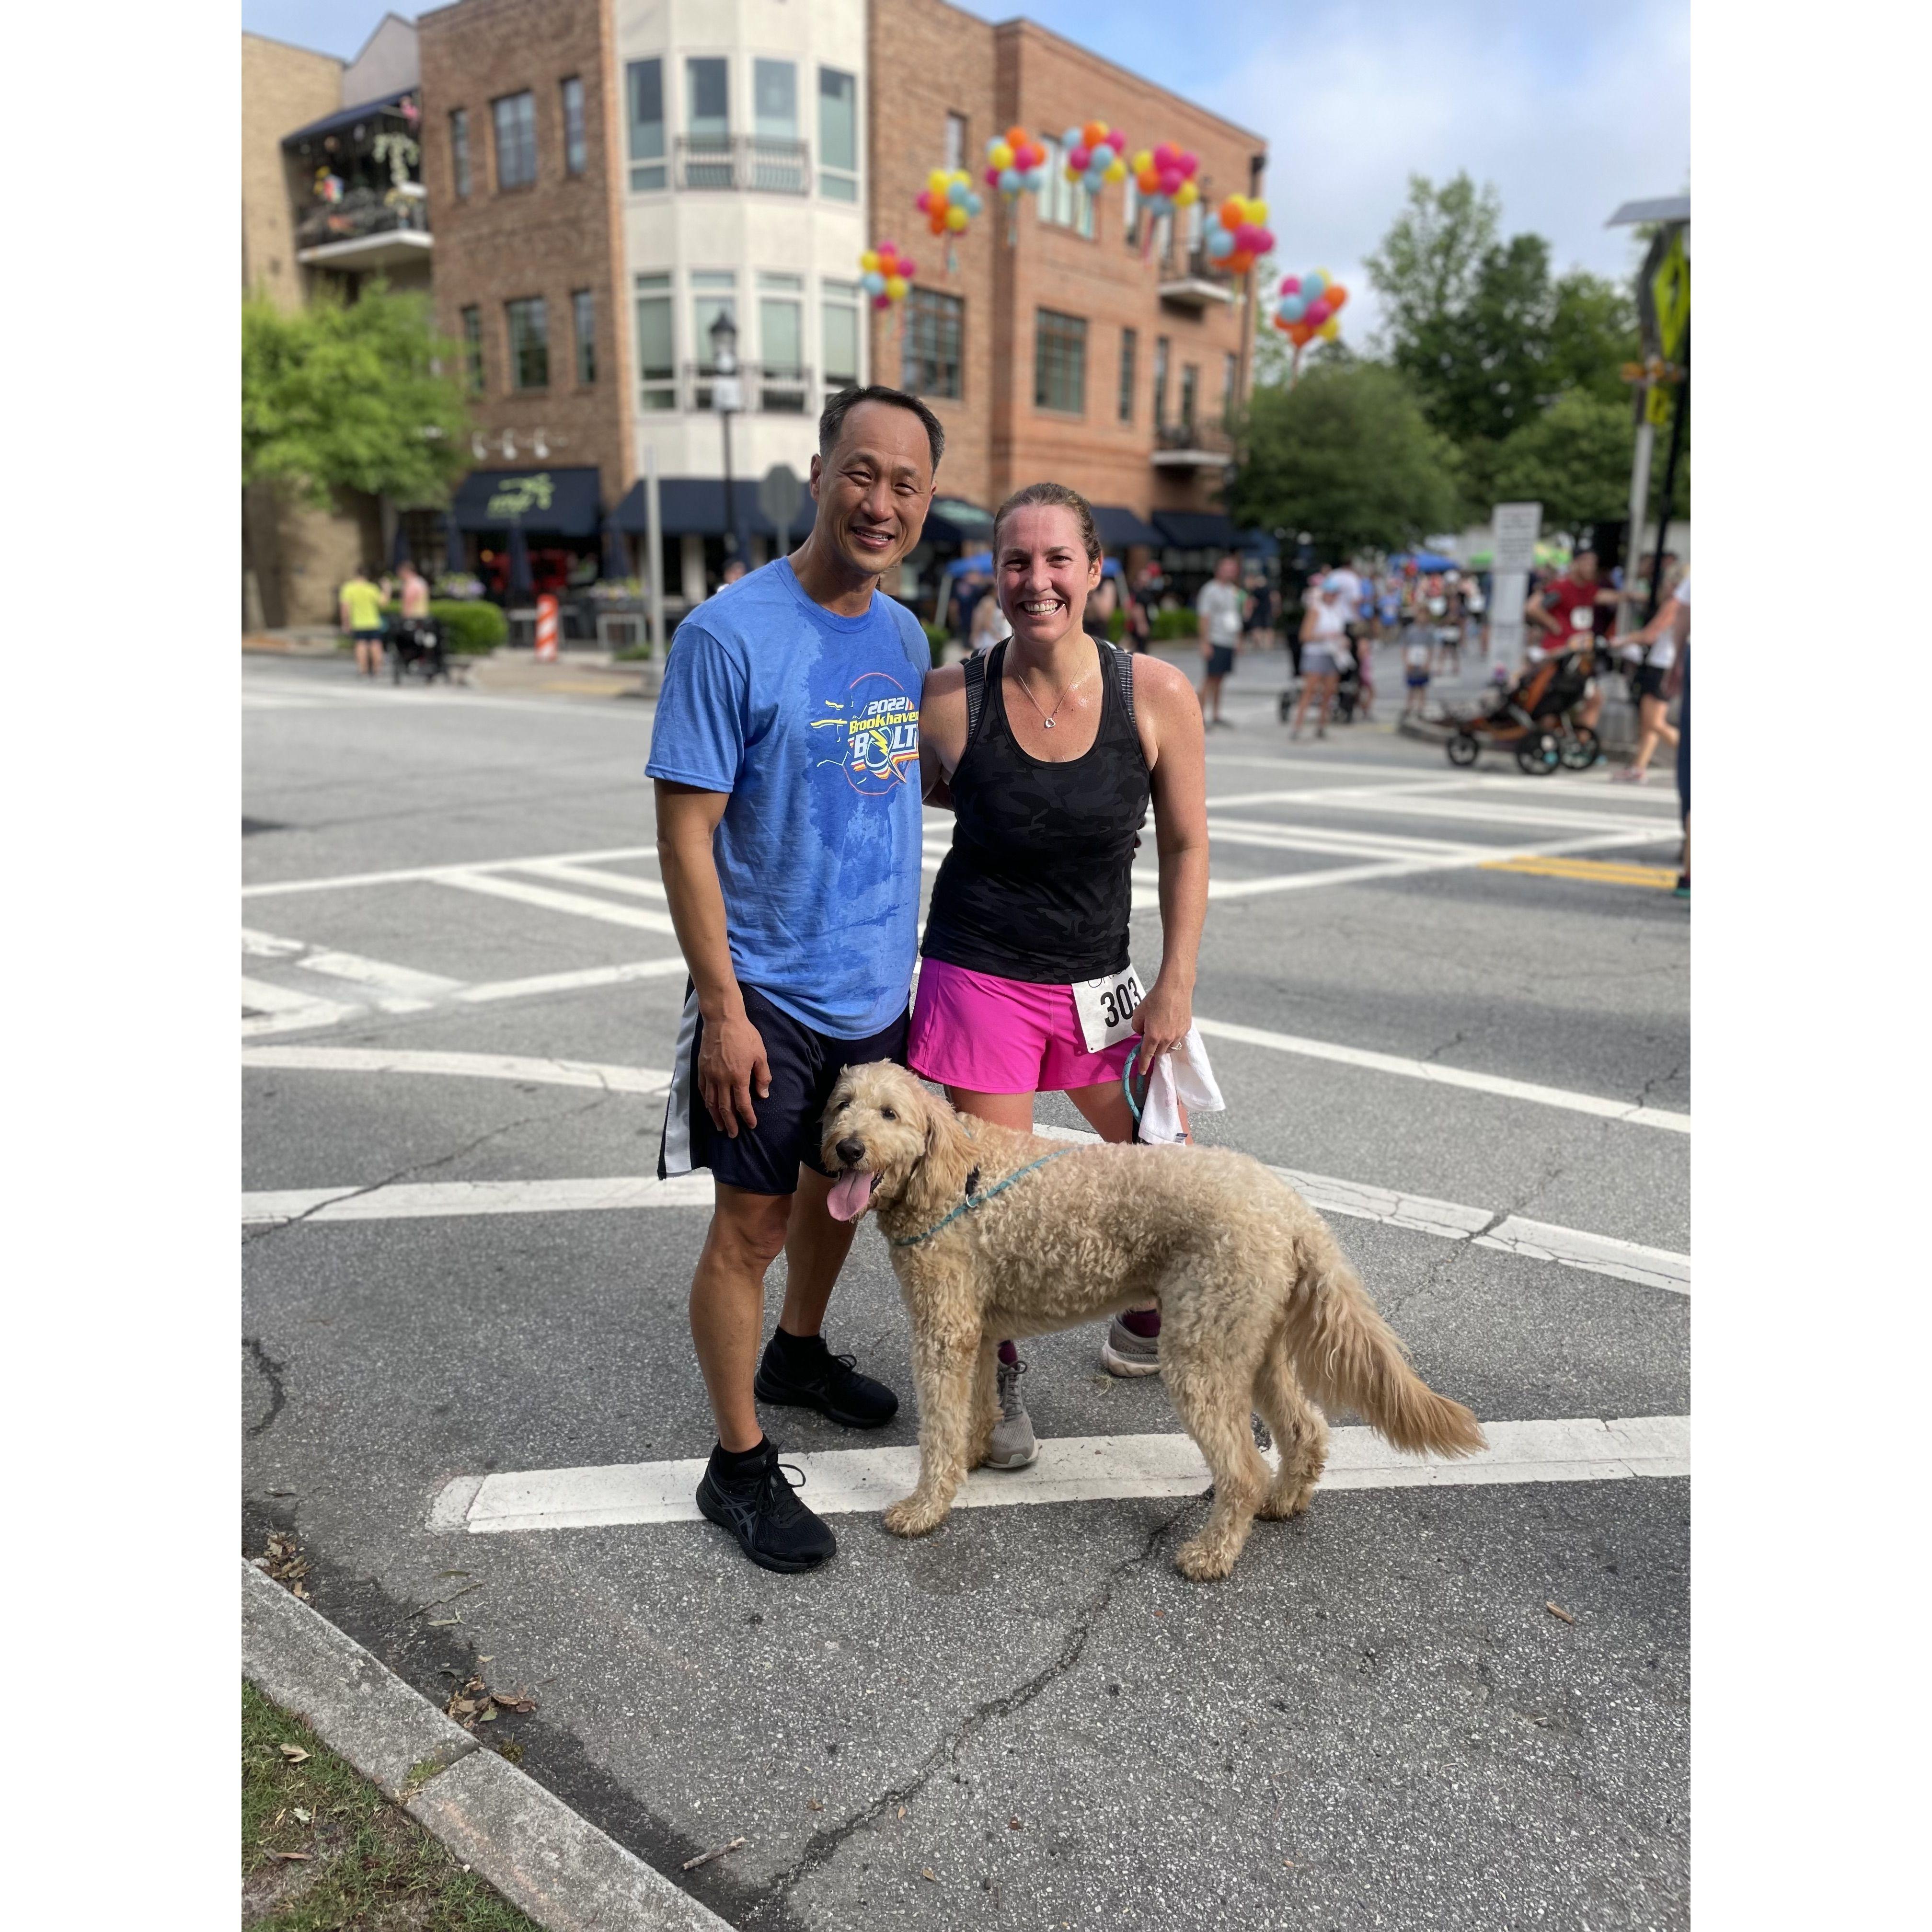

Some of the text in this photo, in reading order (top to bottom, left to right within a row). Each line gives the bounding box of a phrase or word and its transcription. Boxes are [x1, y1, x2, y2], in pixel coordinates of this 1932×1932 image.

[867, 696, 906, 715] 2022
[849, 711, 919, 735] Brookhaven
[1100, 977, 1142, 1027] 303
